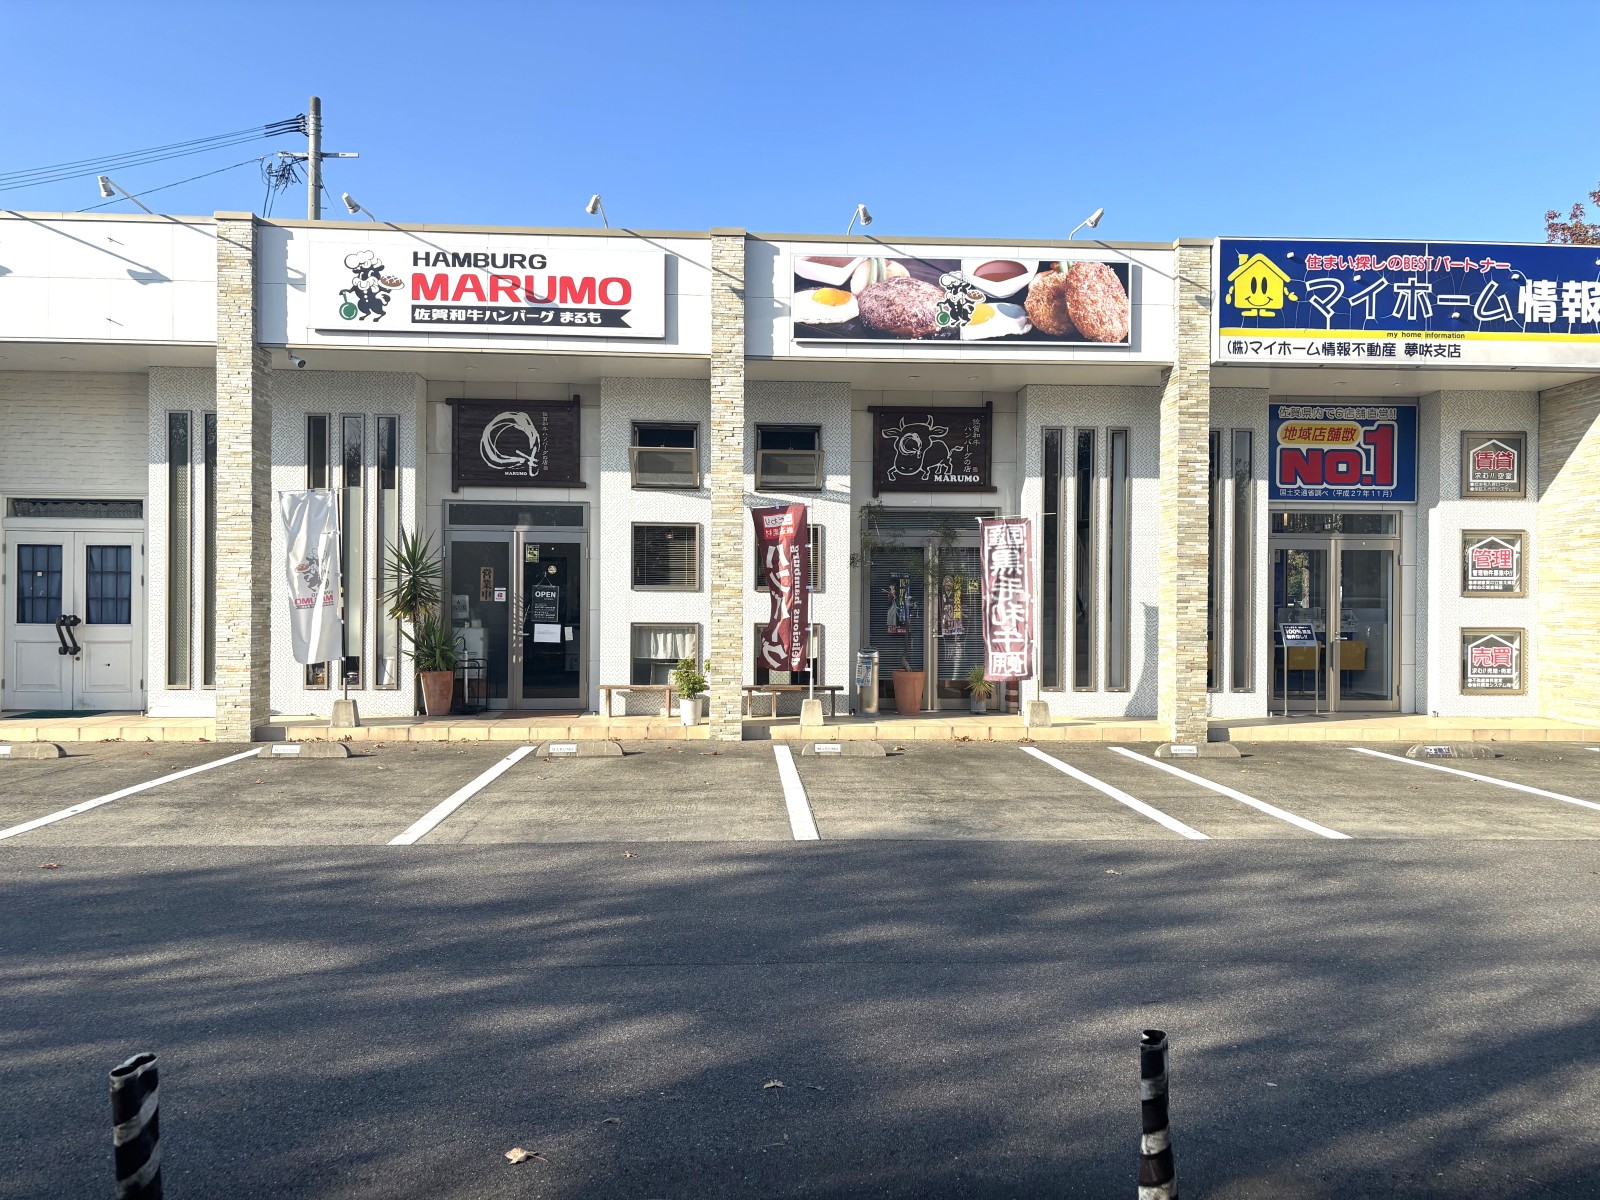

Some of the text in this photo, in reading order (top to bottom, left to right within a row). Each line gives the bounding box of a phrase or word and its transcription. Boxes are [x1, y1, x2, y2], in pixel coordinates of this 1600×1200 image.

[412, 250, 547, 270] HAMBURG
[1305, 254, 1511, 273] 住まい探しのBESTパートナー
[411, 272, 632, 306] MARUMO
[414, 308, 602, 325] 佐賀和牛ハンバーグ まるも
[1425, 331, 1465, 339] information
[1227, 340, 1461, 358] (株)マイホーム情報不動産 夢咲支店
[1283, 426, 1357, 442] 地域店舗数
[963, 426, 973, 473] ハンバーグの店
[1279, 422, 1396, 486] NO.1
[1474, 450, 1514, 471] 賃貸
[933, 474, 980, 483] MARUMO
[1473, 548, 1513, 569] 管理
[482, 568, 492, 600] 営業中
[535, 590, 556, 598] OPEN
[1472, 646, 1512, 667] 売買
